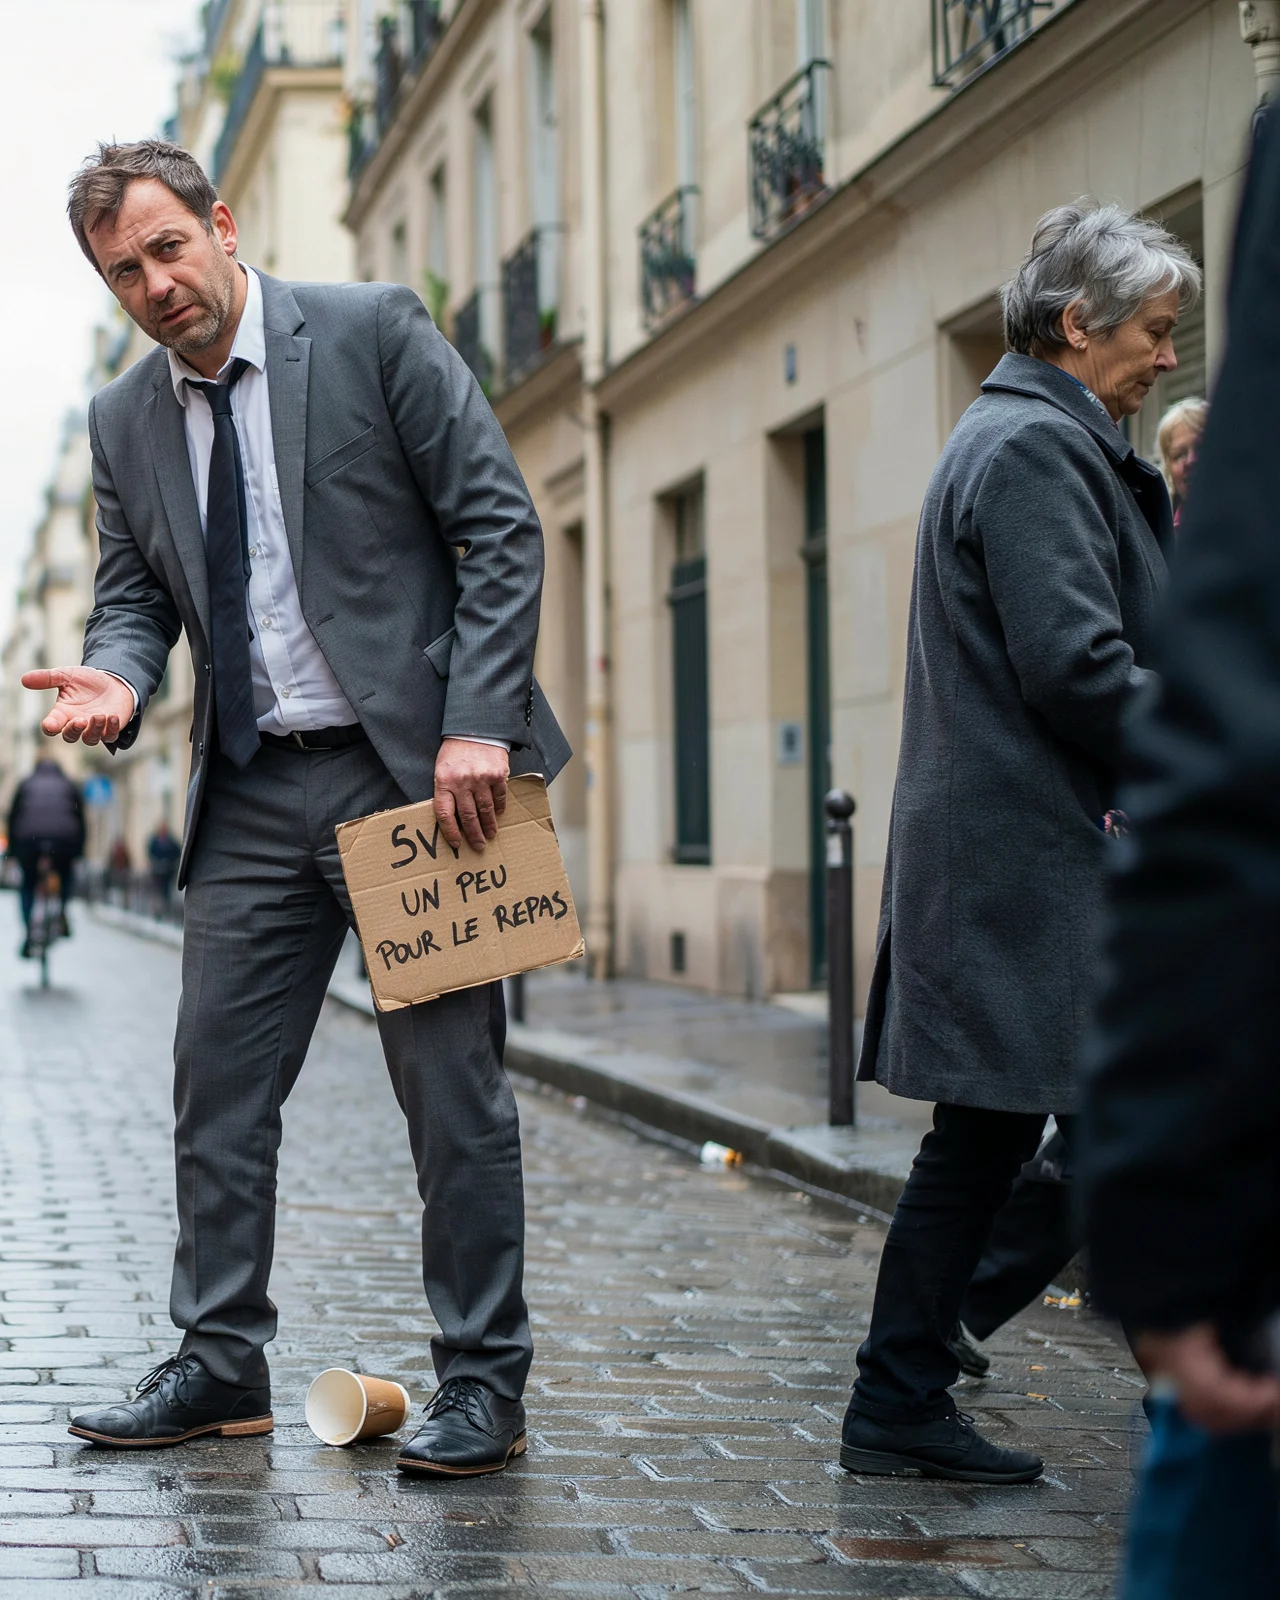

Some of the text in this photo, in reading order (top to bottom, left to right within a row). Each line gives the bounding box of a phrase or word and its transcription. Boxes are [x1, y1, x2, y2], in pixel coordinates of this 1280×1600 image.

[390, 821, 460, 869] SV
[401, 864, 507, 916] UN PEU
[375, 890, 568, 971] POUR LE REPAS
